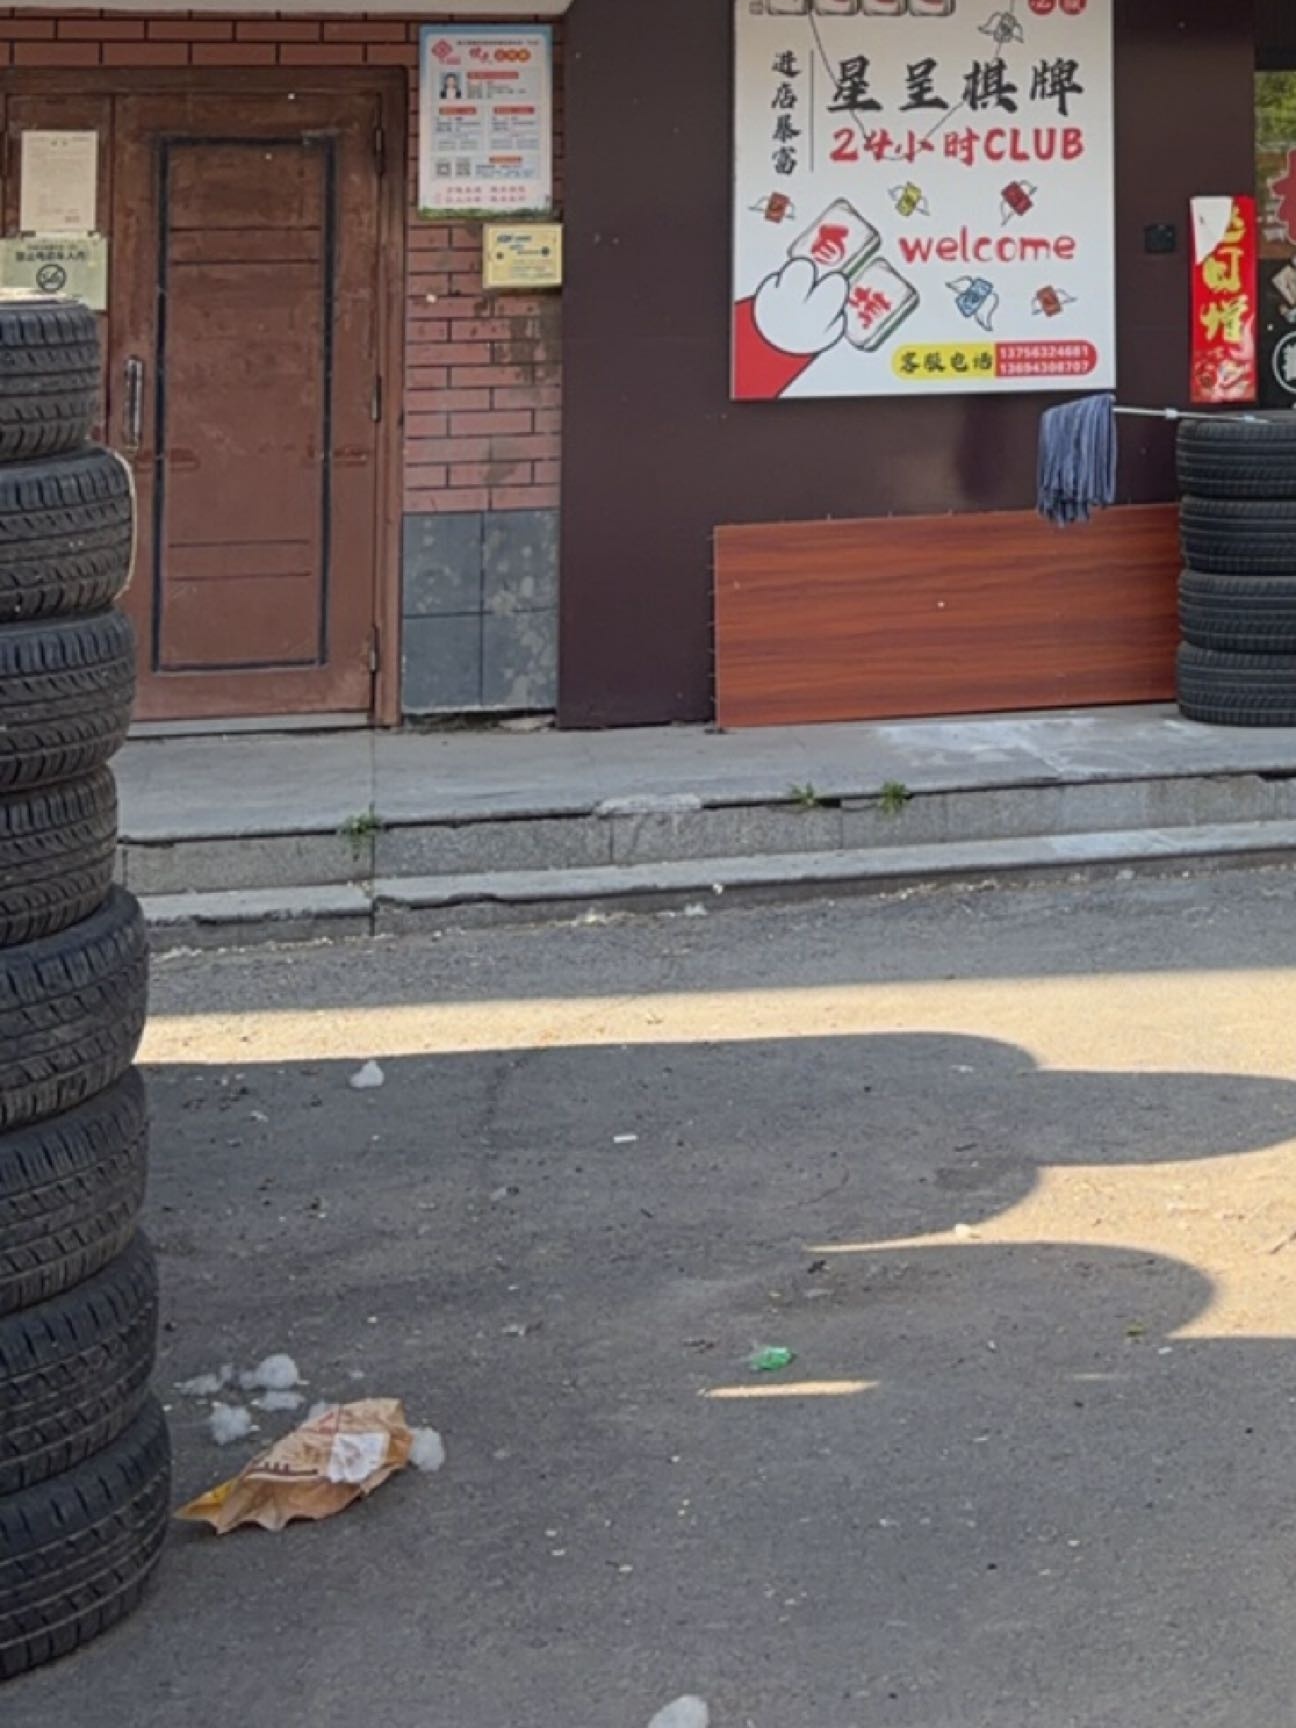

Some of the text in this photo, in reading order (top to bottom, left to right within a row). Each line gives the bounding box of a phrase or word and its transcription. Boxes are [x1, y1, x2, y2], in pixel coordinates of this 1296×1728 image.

[826, 54, 1085, 117] 星呈棋牌
[898, 224, 1078, 265] welcome
